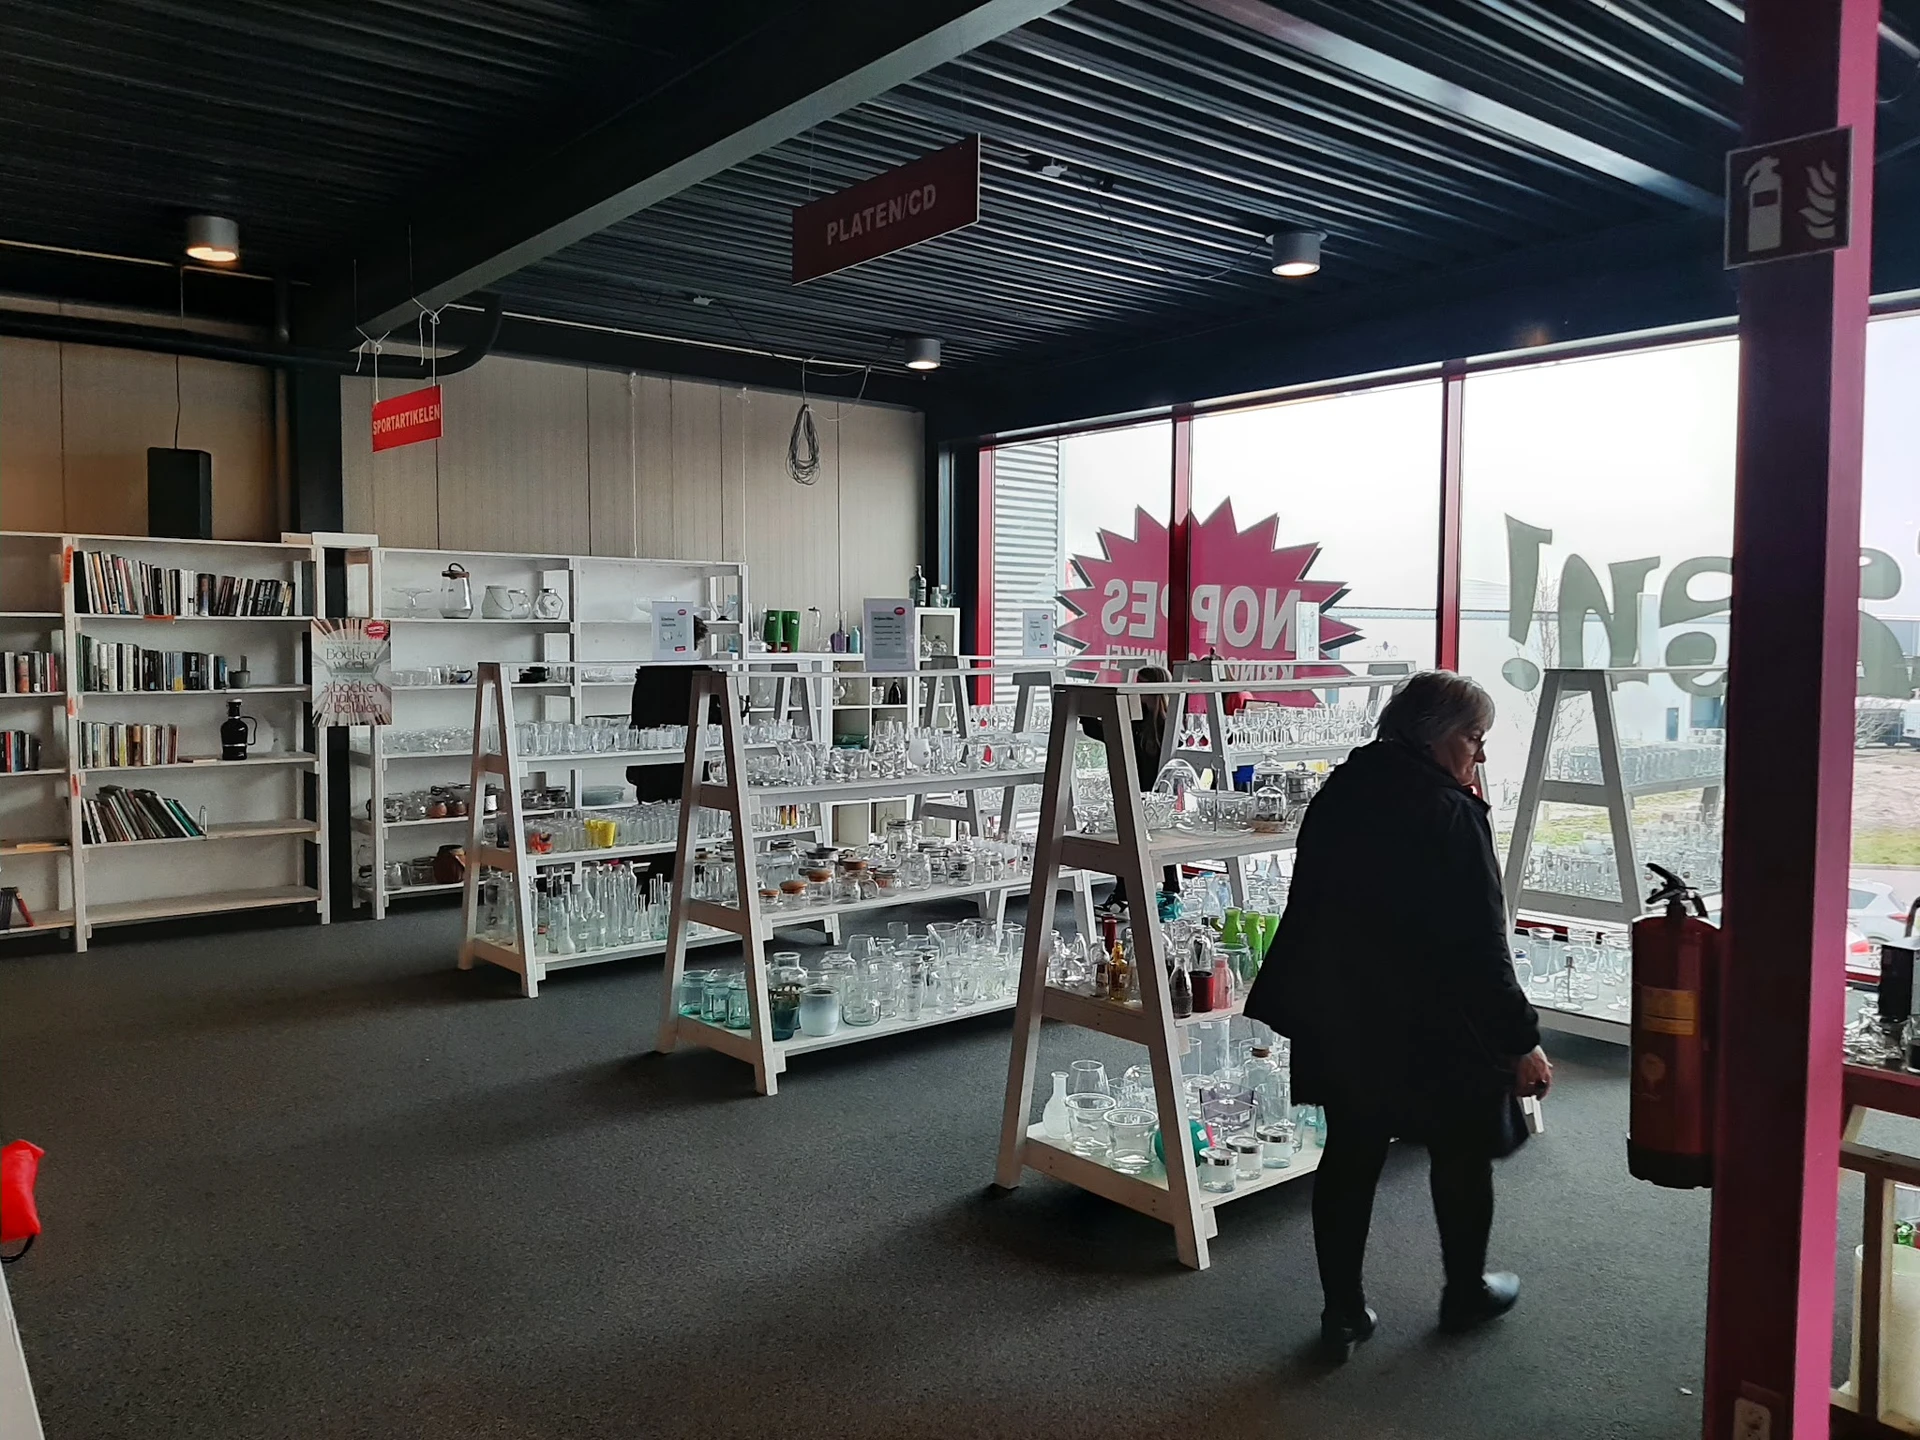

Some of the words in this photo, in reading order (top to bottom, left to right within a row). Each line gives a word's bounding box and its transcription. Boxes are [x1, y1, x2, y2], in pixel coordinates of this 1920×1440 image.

[826, 183, 937, 246] PLATEN/CD
[372, 403, 440, 436] SPORTARTIKELEN
[333, 680, 384, 693] boeken
